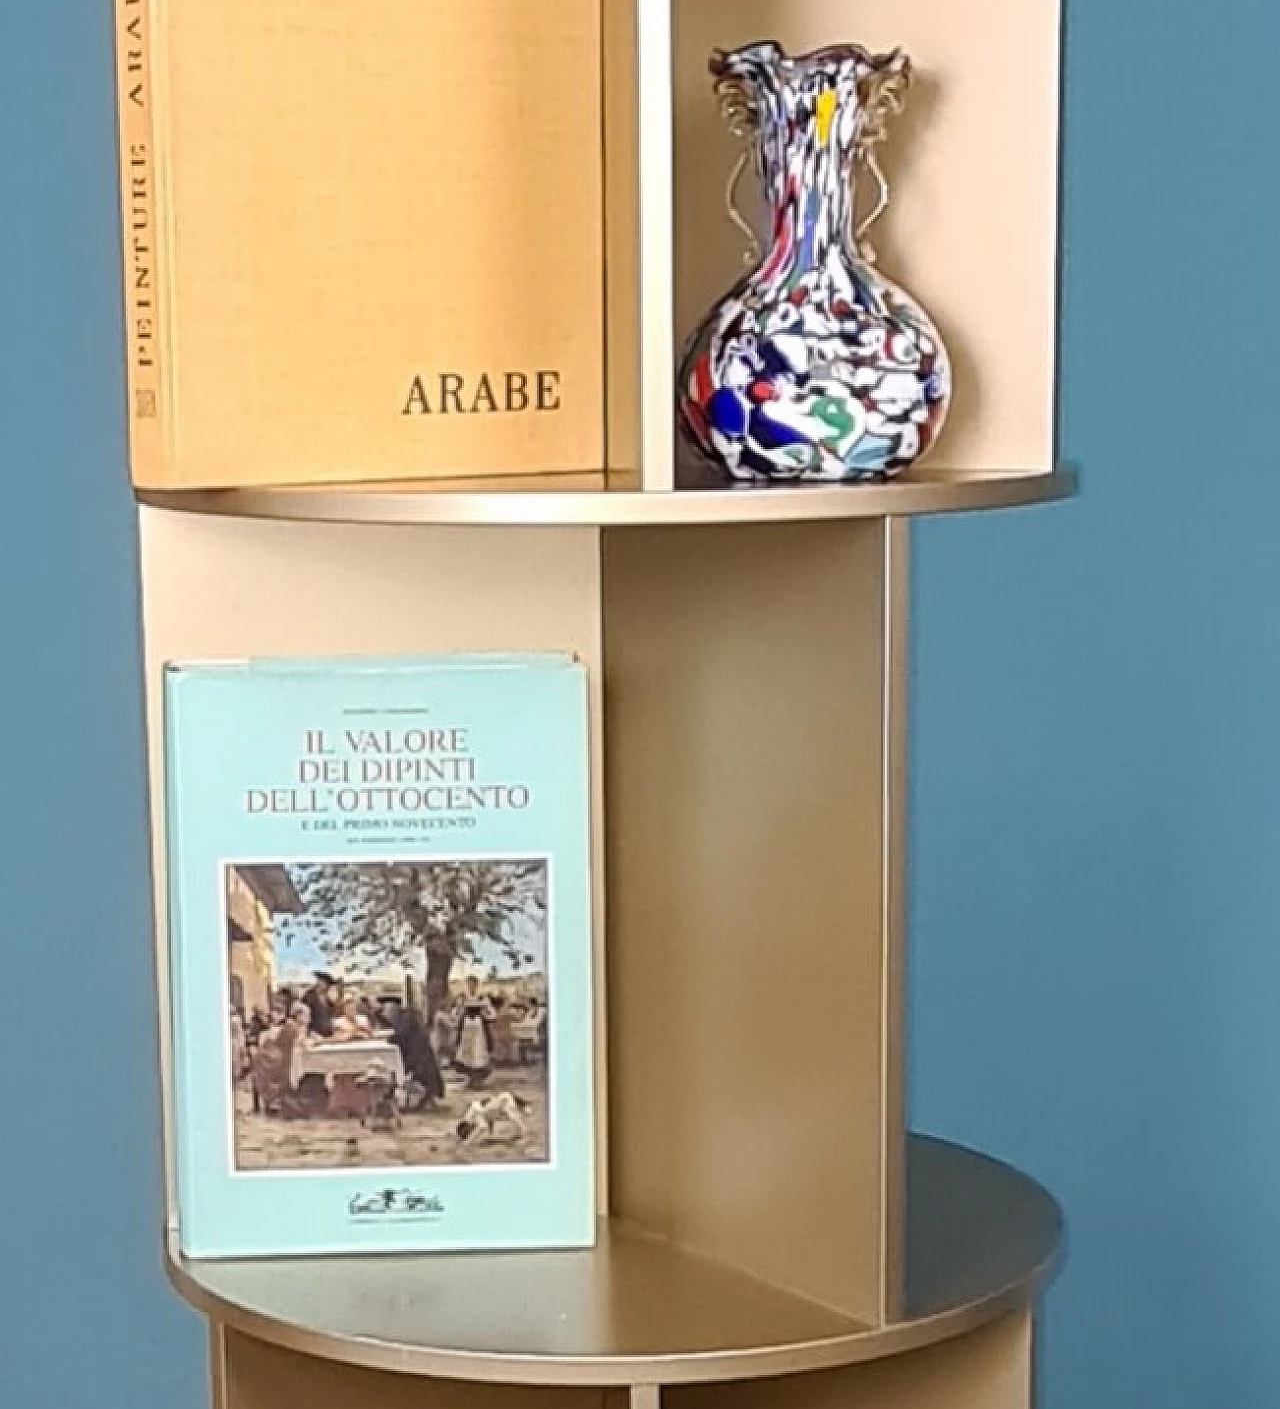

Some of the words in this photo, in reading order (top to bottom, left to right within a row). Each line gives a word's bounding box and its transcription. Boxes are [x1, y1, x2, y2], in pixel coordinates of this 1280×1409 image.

[130, 144, 154, 368] PEINTURE
[400, 369, 563, 417] ARABE
[306, 729, 335, 754] IL
[345, 727, 469, 754] VALORE
[300, 758, 350, 783] DEI
[361, 757, 475, 782] DIPINTI
[246, 784, 530, 813] DELL'OTTOCENTO
[343, 818, 389, 830] PRIMO
[392, 816, 477, 830] NOVECENTO
